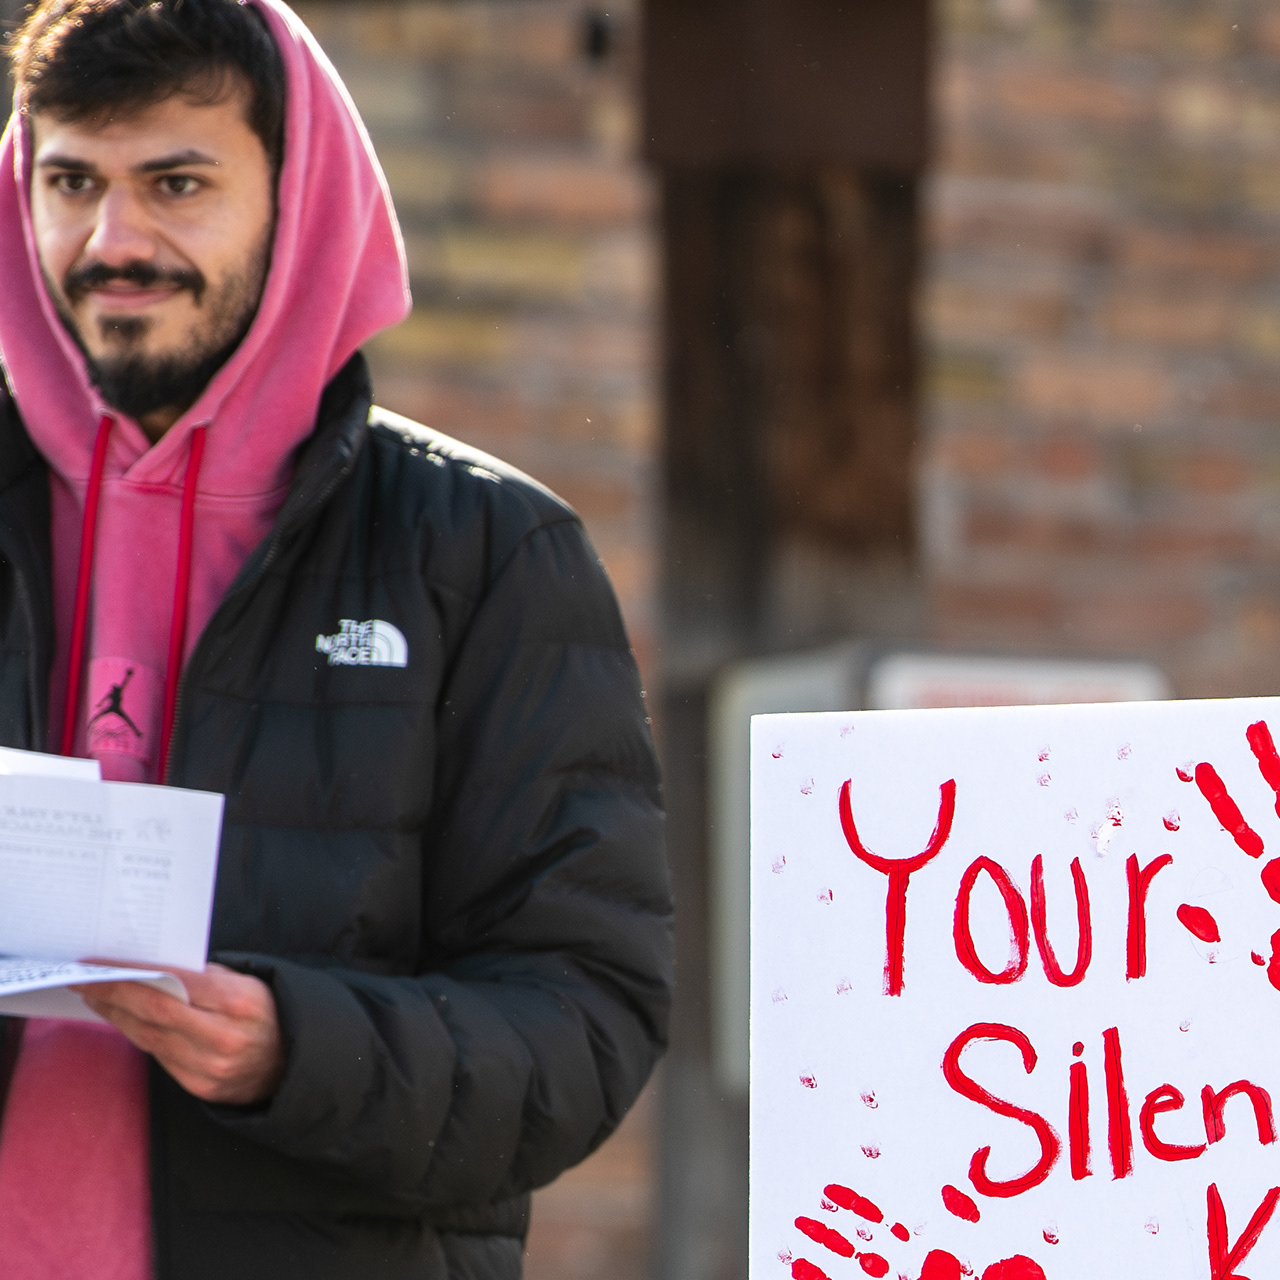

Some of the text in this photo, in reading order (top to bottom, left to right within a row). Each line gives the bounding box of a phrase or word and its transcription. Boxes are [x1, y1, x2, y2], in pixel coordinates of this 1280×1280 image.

[338, 619, 374, 634] THE
[327, 646, 372, 666] FACE
[839, 778, 1174, 997] Your
